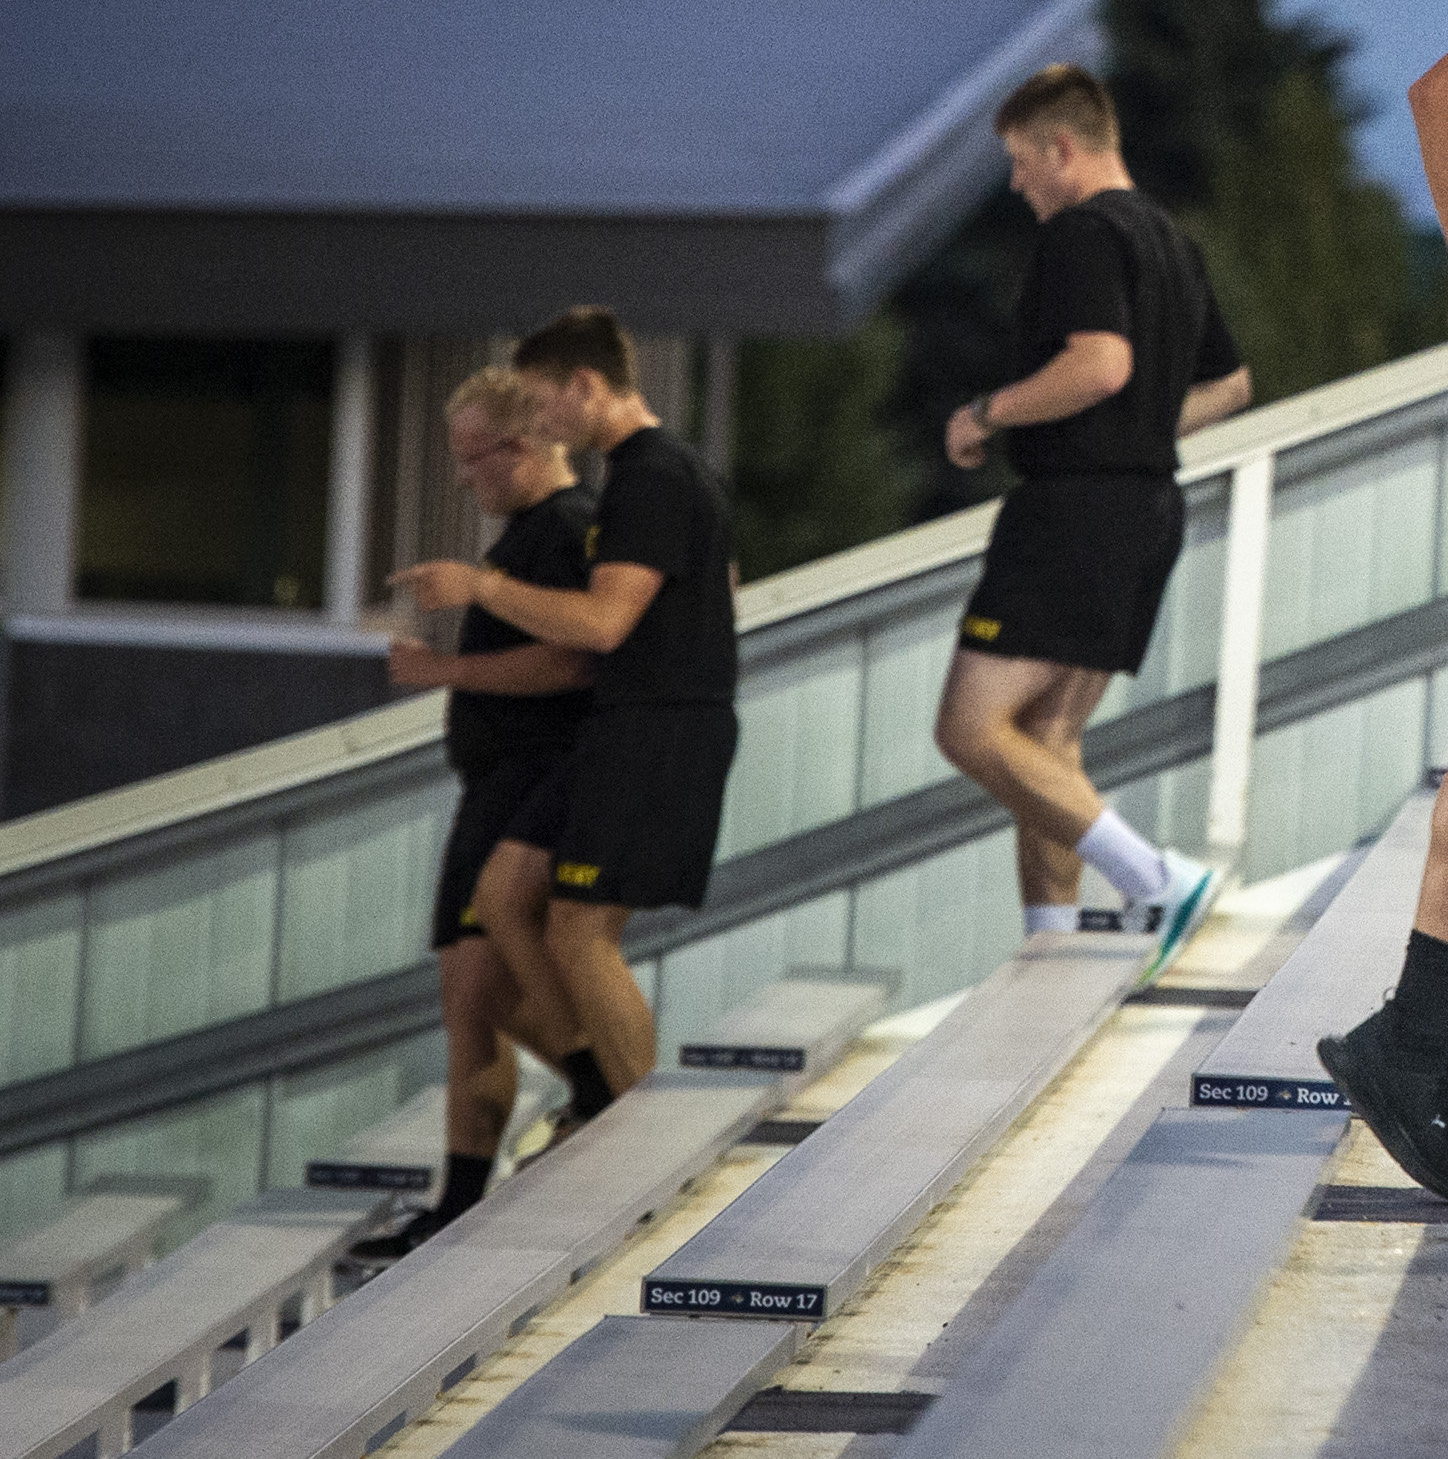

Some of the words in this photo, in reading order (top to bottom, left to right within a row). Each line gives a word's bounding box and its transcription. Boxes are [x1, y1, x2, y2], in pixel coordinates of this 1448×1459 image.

[1200, 1083, 1232, 1100] Sec
[1236, 1085, 1269, 1102] 109
[1296, 1087, 1341, 1105] Row
[651, 1287, 684, 1305] Sec
[688, 1289, 721, 1306] 109
[750, 1291, 792, 1308] Row
[796, 1293, 818, 1310] 17
